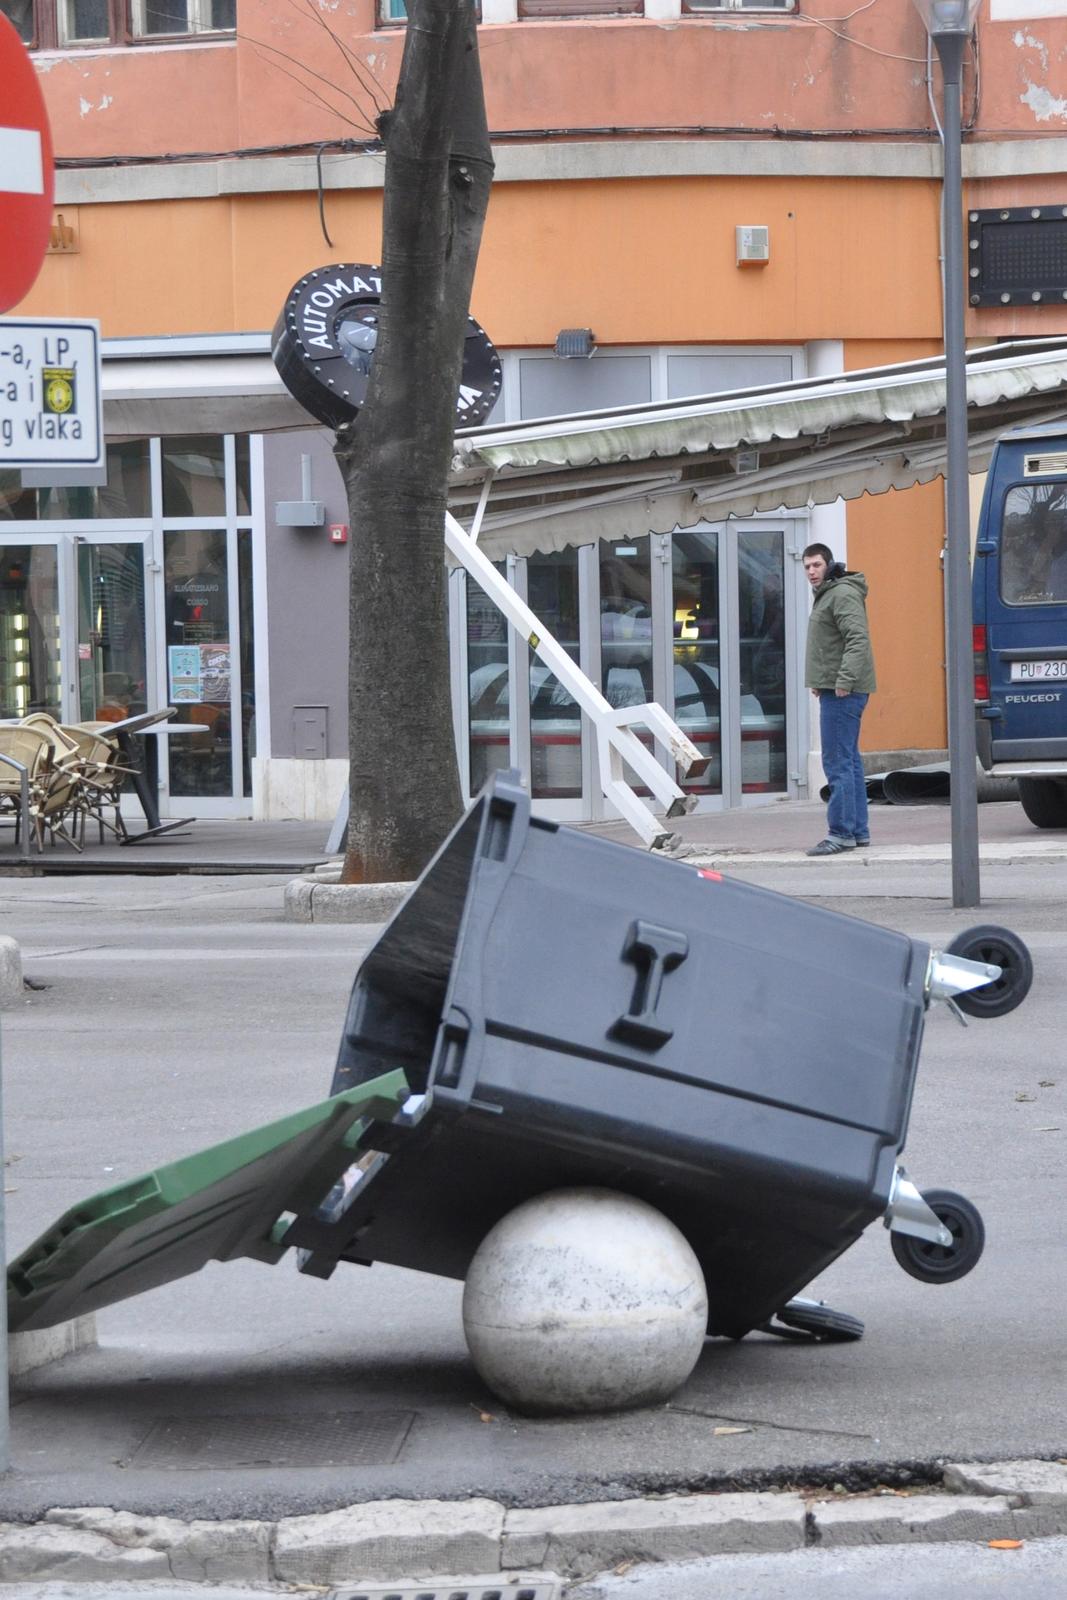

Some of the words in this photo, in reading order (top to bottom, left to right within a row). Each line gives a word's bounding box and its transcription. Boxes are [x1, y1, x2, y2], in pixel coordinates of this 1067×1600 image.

[29, 375, 34, 402] i
[25, 412, 82, 440] vlaka
[1005, 693, 1062, 703] PEUGEOT
